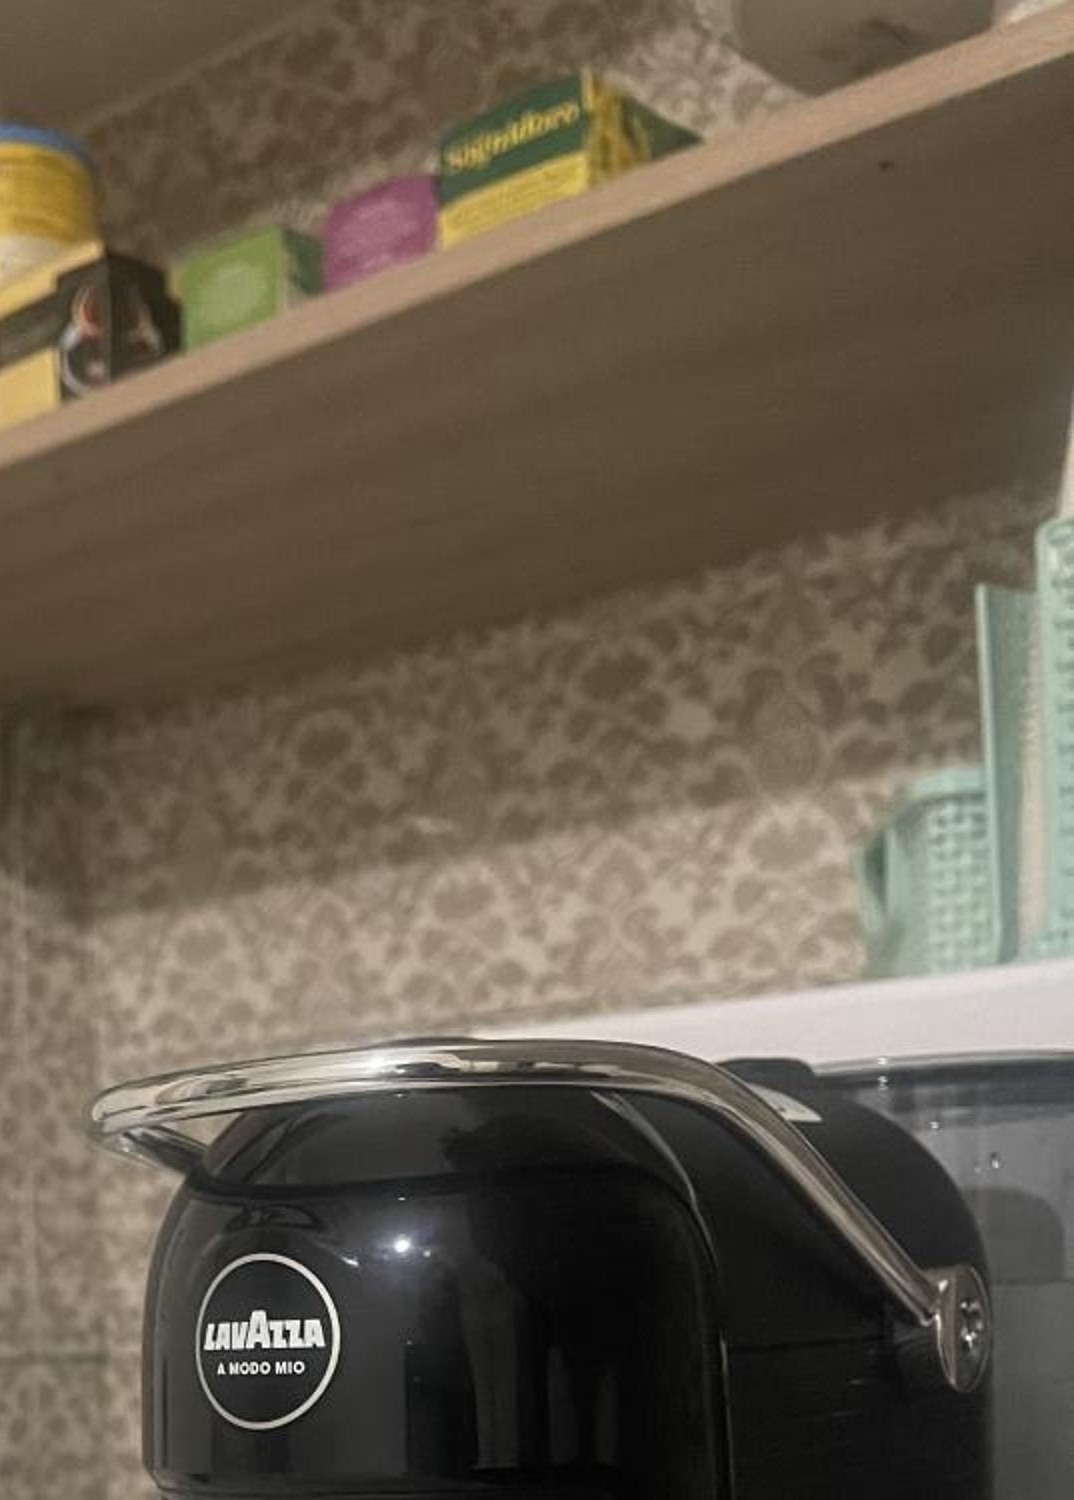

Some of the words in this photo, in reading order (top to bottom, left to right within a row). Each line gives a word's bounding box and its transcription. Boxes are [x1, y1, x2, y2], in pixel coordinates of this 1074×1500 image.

[204, 1310, 325, 1351] LAVAZZA
[217, 1362, 227, 1375] A
[229, 1361, 271, 1375] MODO
[275, 1361, 305, 1375] MIO
